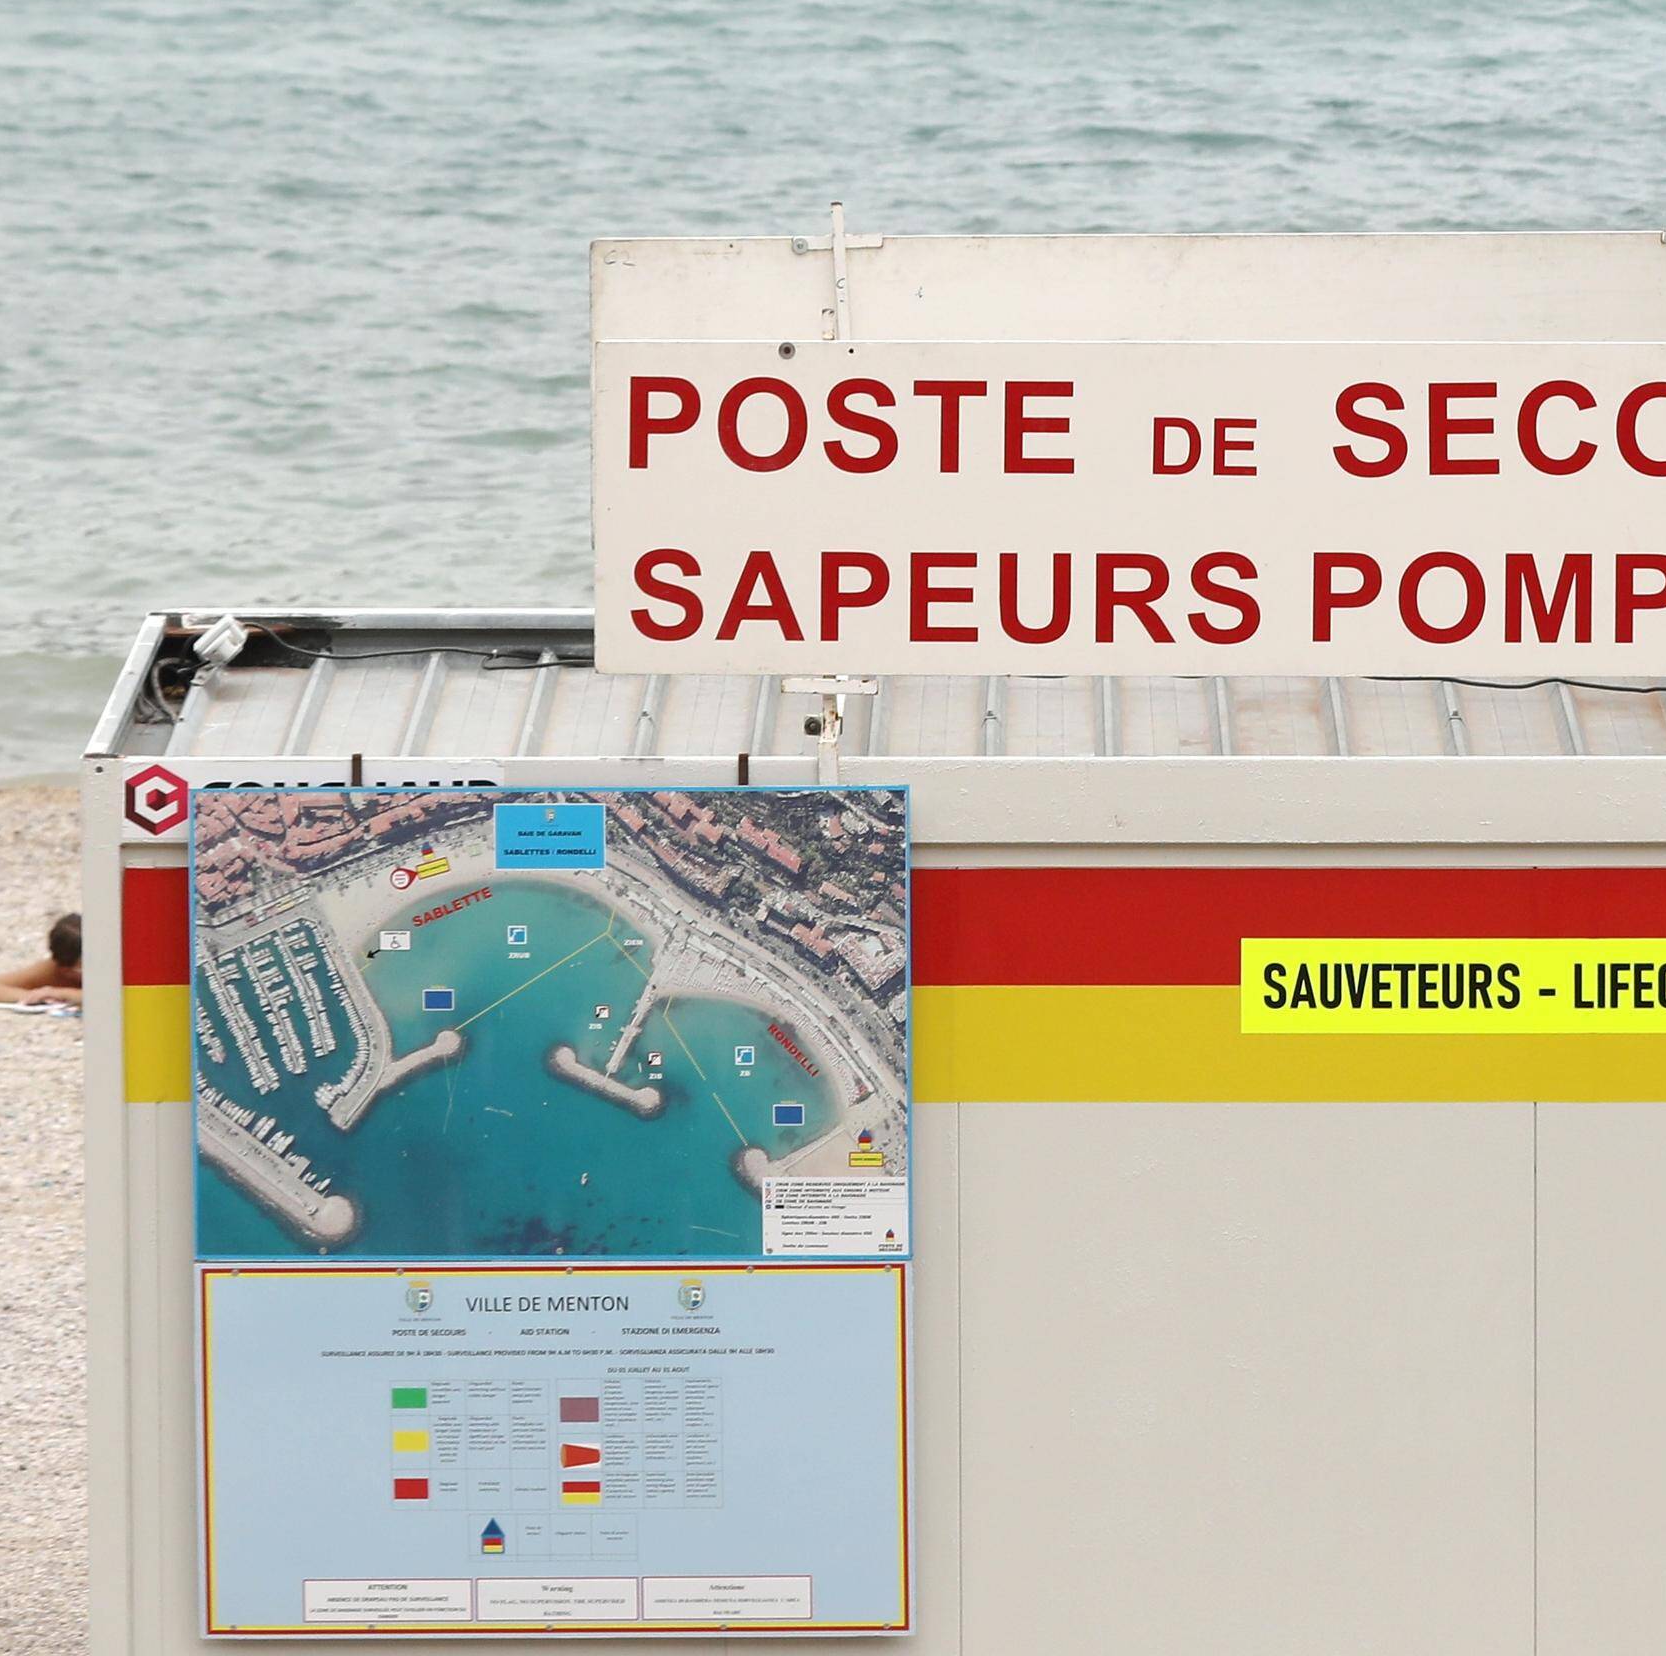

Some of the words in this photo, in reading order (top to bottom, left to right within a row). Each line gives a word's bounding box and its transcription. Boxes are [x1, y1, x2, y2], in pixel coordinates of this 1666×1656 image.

[627, 375, 1076, 474] POSTE
[1151, 416, 1259, 476] DE
[629, 547, 1262, 645] SAPEURS
[503, 848, 550, 856] SABLETTES
[411, 886, 494, 928] SABLETTE
[1262, 962, 1522, 1010] SAUVETEURS
[1539, 987, 1557, 997] -
[767, 1022, 821, 1078] RONDELLI
[465, 1296, 512, 1312] VILLE
[518, 1296, 542, 1312] DE
[547, 1295, 630, 1312] MENTON
[391, 1328, 417, 1337] POSTE
[418, 1328, 430, 1337] DE
[430, 1328, 467, 1337] SECOURS
[520, 1328, 535, 1336] AID
[535, 1328, 570, 1336] STATION
[621, 1327, 660, 1336] STAZIONE
[661, 1327, 670, 1335] DI
[671, 1326, 721, 1335] EMERGENZA
